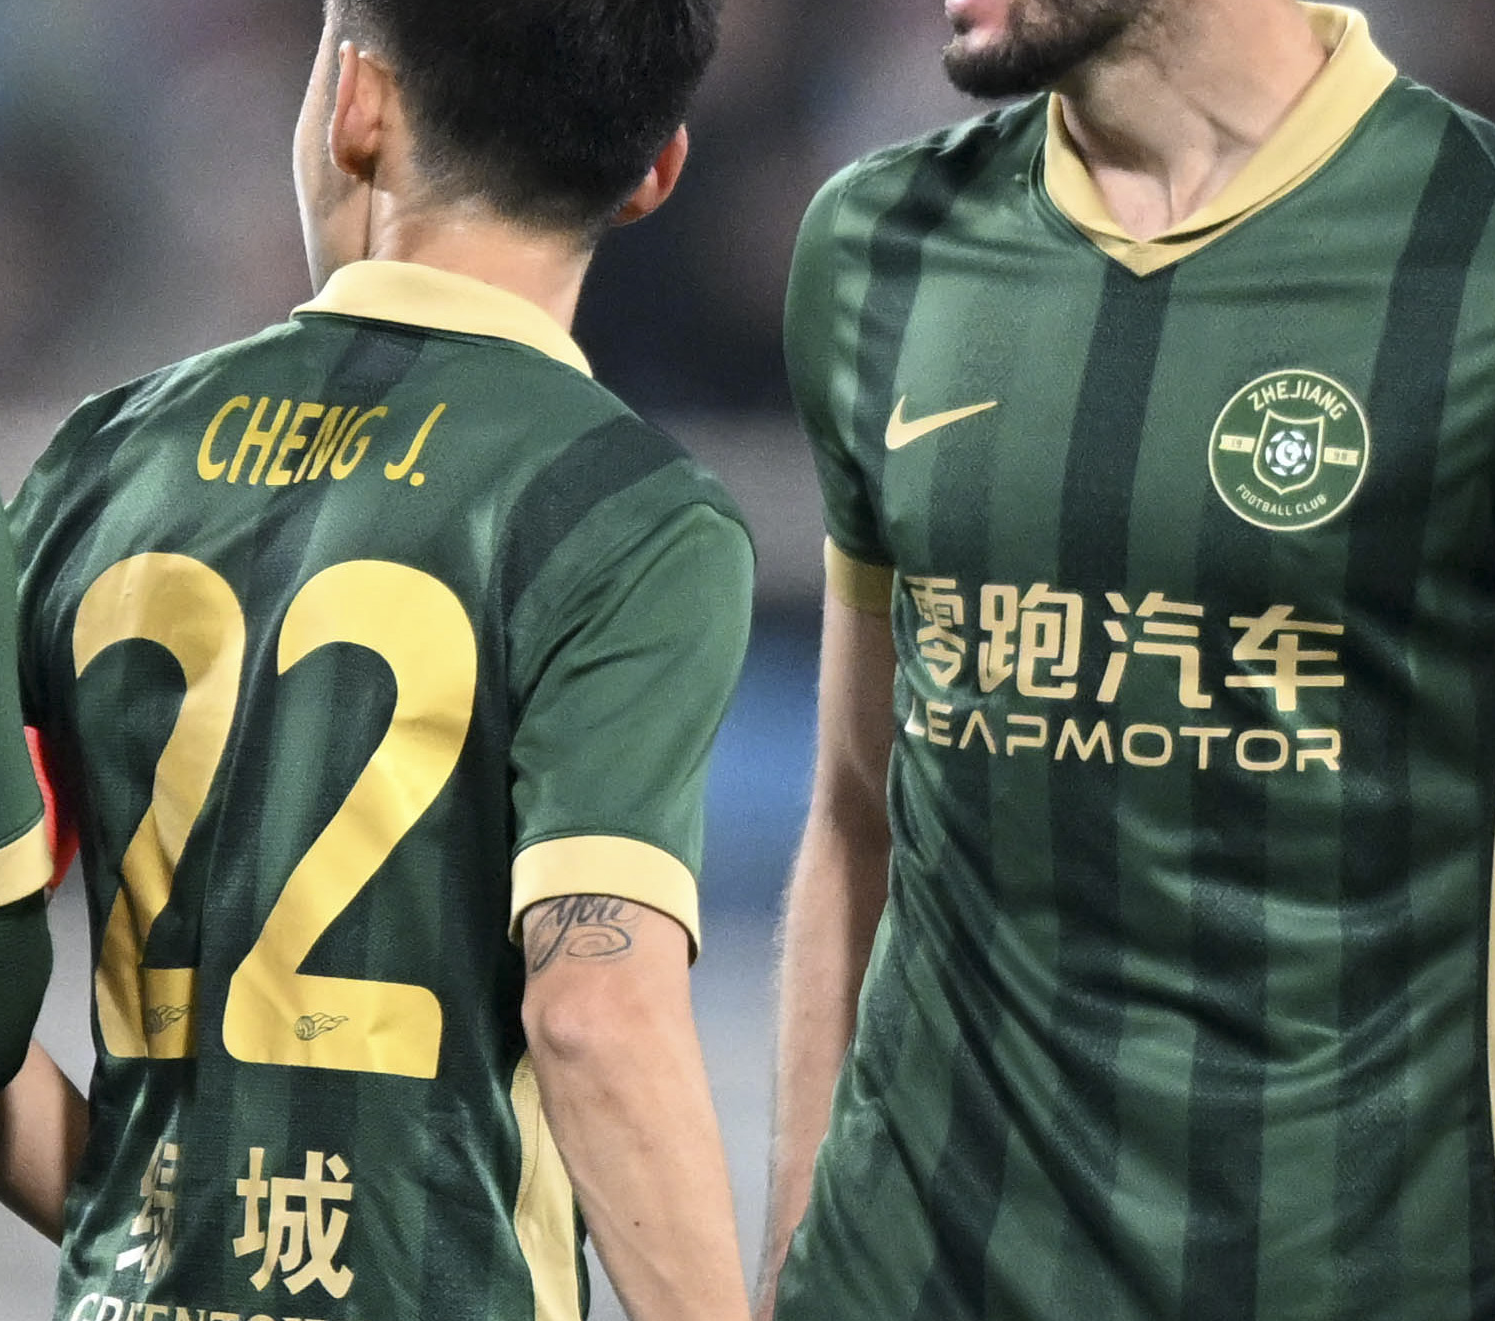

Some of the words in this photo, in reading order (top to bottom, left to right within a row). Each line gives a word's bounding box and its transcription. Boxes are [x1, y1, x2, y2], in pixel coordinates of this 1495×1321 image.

[197, 395, 389, 485] CHENG
[384, 403, 447, 486] J.
[1247, 380, 1348, 421] ZHEJIANG
[1236, 483, 1293, 517] FOOTBALL
[1295, 493, 1328, 516] CLUB
[904, 575, 1345, 712] 零跑汽车
[904, 696, 1342, 772] LEAPMOTOR
[73, 552, 477, 1079] 22
